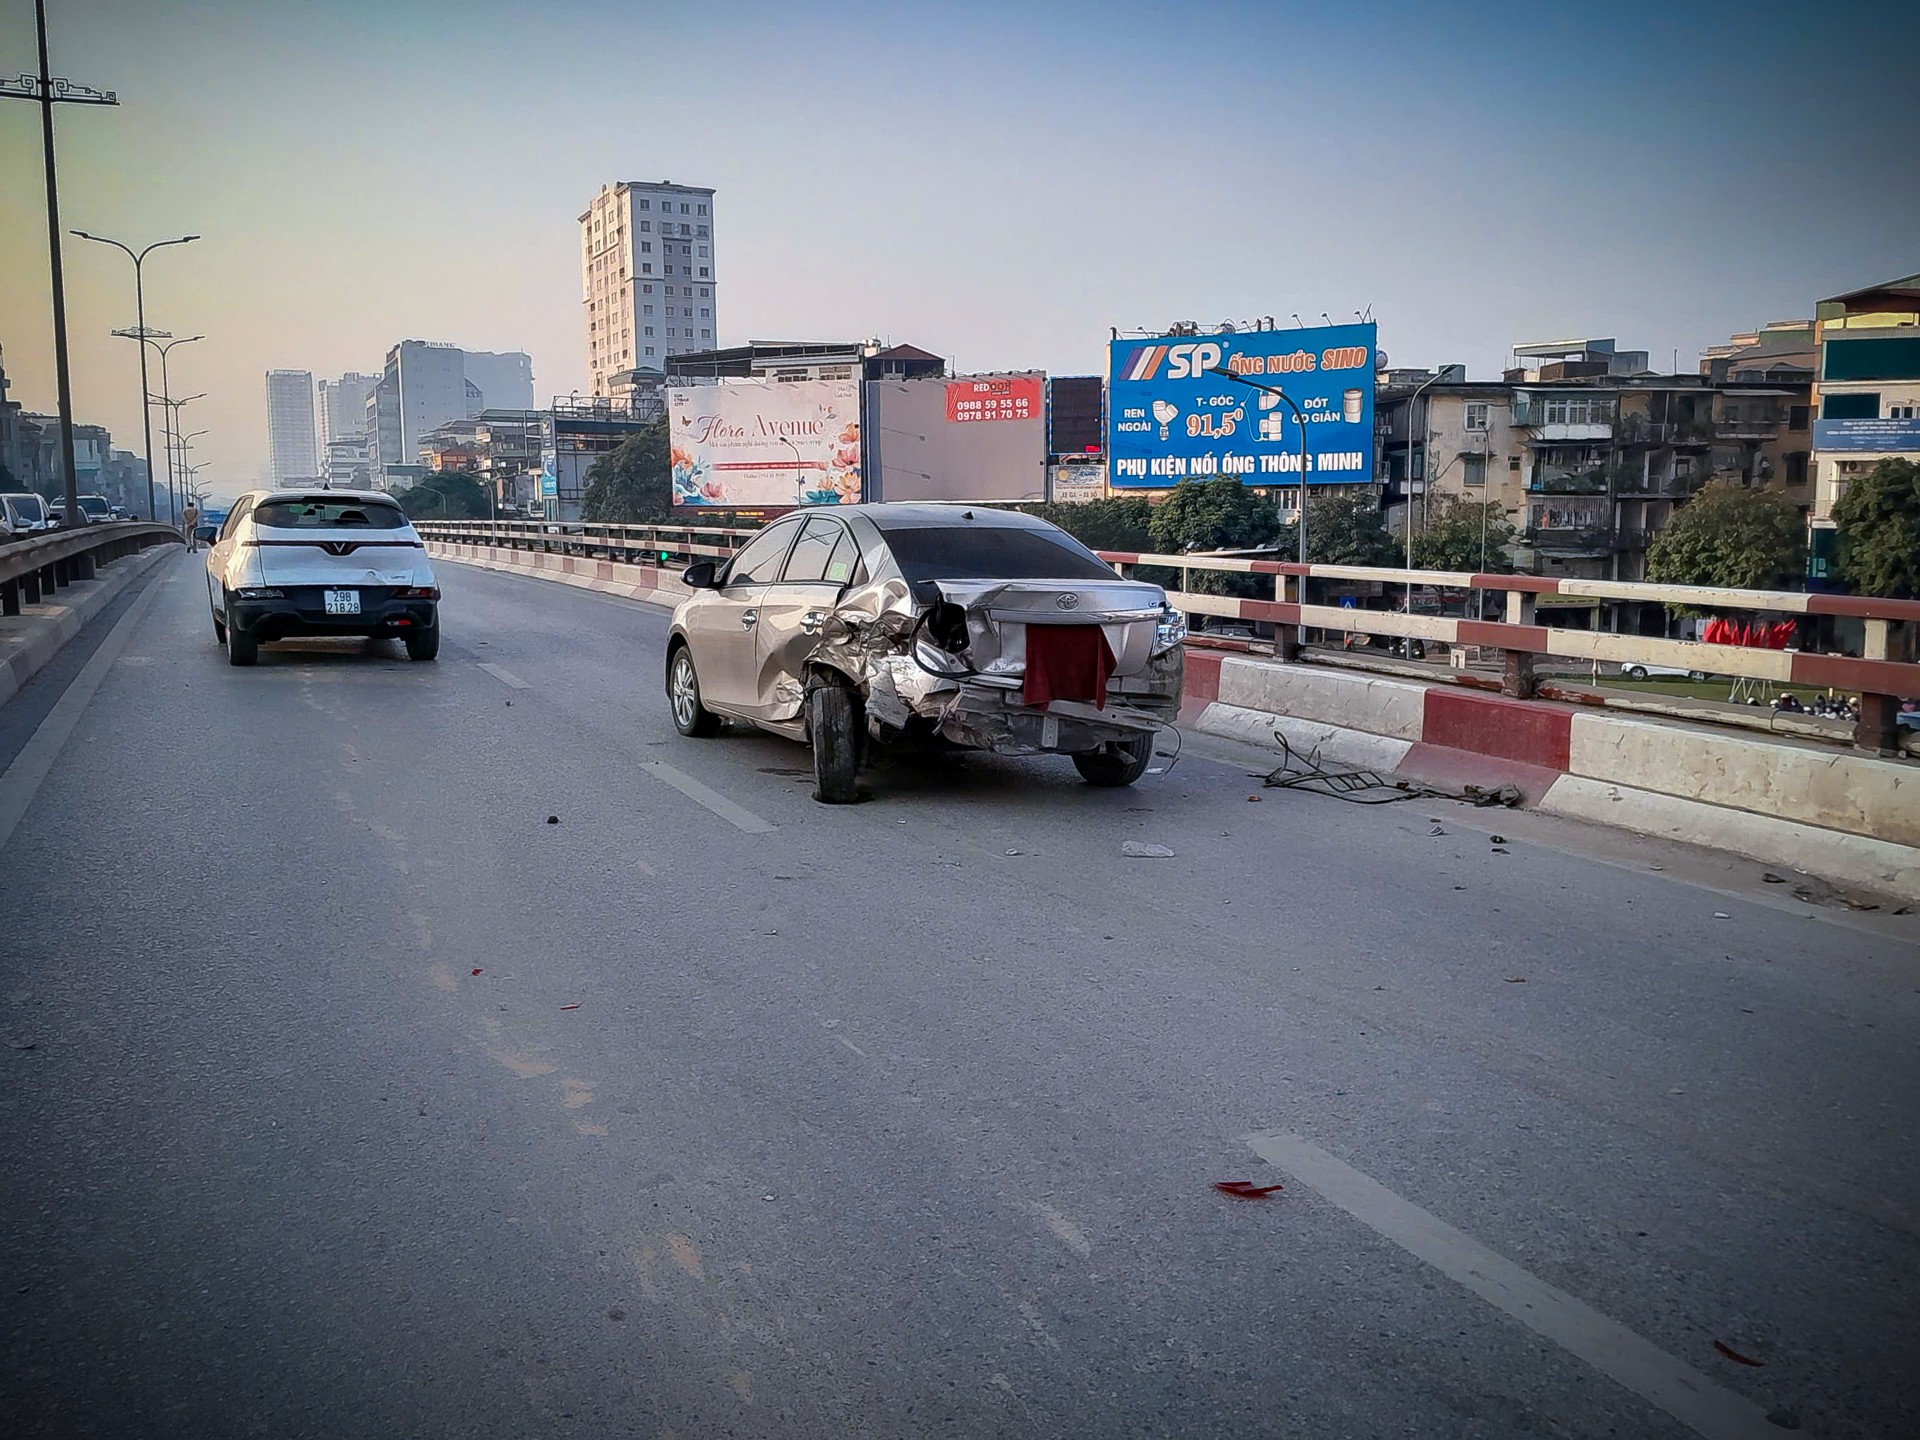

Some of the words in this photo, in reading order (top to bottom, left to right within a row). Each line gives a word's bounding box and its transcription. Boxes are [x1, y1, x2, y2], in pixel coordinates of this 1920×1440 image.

[1167, 343, 1221, 379] SP
[1228, 351, 1264, 375] ỐNG
[1267, 350, 1316, 374] NƯỚC
[1321, 346, 1367, 370] SINO
[957, 401, 982, 410] 0988
[985, 400, 997, 409] 59
[1000, 399, 1013, 408] 55
[1016, 398, 1028, 407] 66
[1209, 394, 1234, 407] GÓC
[957, 411, 982, 420] 0978
[985, 410, 997, 419] 91
[1000, 410, 1013, 418] 70
[1016, 409, 1028, 418] 75
[1124, 409, 1145, 418] REN
[1311, 410, 1340, 422] GIÃN
[697, 414, 744, 443] Flora
[752, 414, 823, 436] Avenue
[1117, 420, 1151, 432] NGOÀI
[1117, 459, 1147, 480] PHỤ
[1150, 455, 1187, 479] KIỆN
[1190, 451, 1218, 475] NỐI
[1222, 450, 1255, 474] ỐNG
[1259, 451, 1313, 473] THÔNG
[1317, 452, 1363, 472] MINH
[333, 591, 352, 602] 29B
